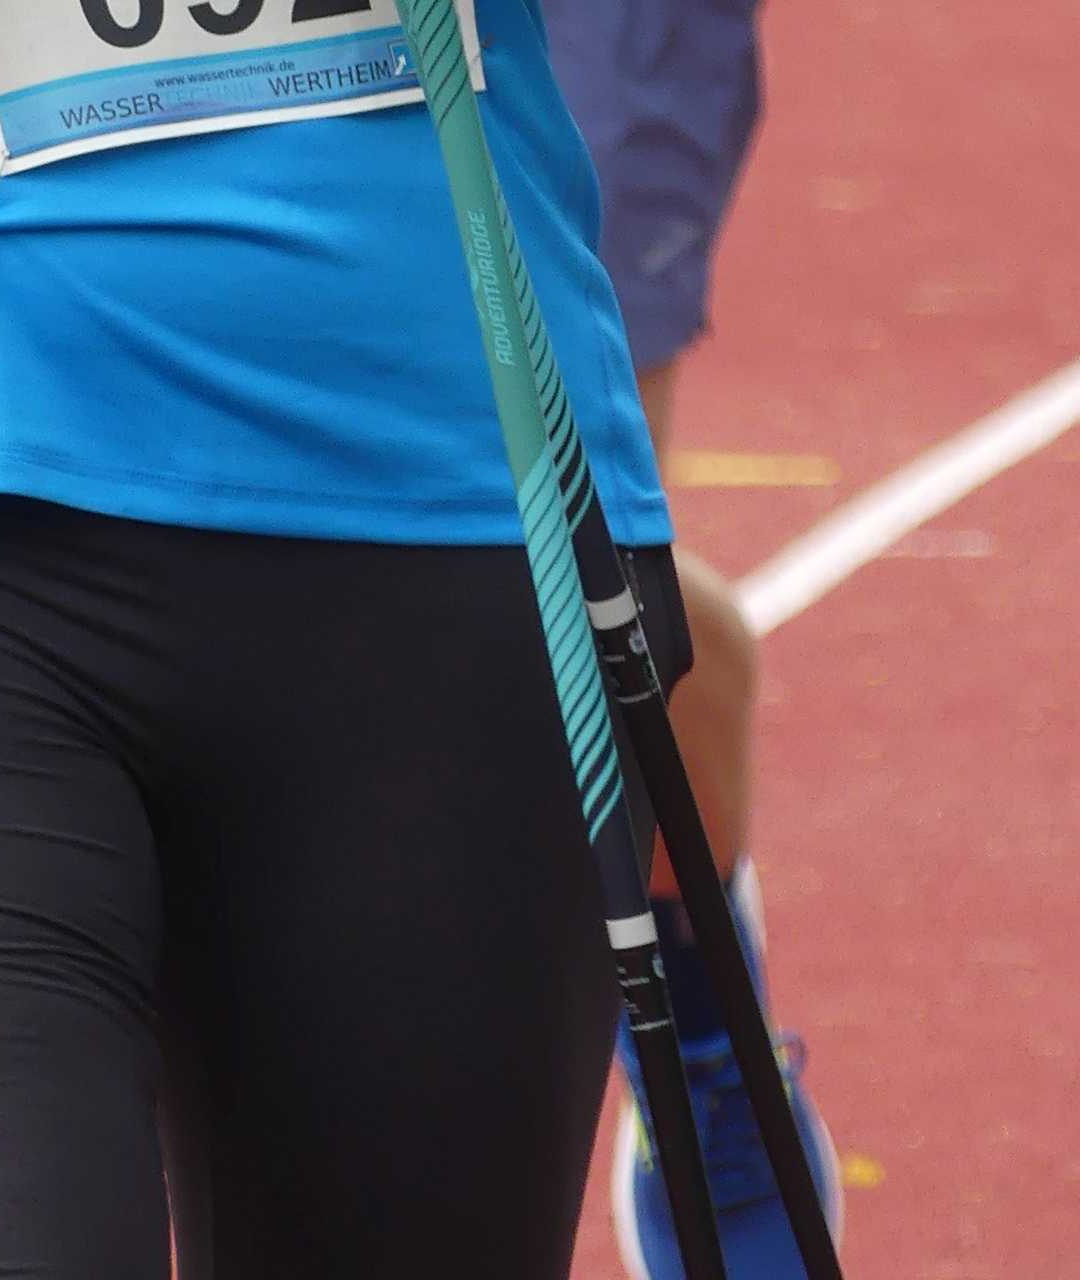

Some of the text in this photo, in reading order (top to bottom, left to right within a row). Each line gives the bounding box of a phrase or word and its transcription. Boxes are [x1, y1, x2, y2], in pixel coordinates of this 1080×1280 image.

[59, 92, 165, 130] WASSER
[268, 59, 393, 98] WERTHEIM
[155, 59, 296, 88] www.wassertechnik.de
[468, 207, 515, 368] ADVENTURIDGE
